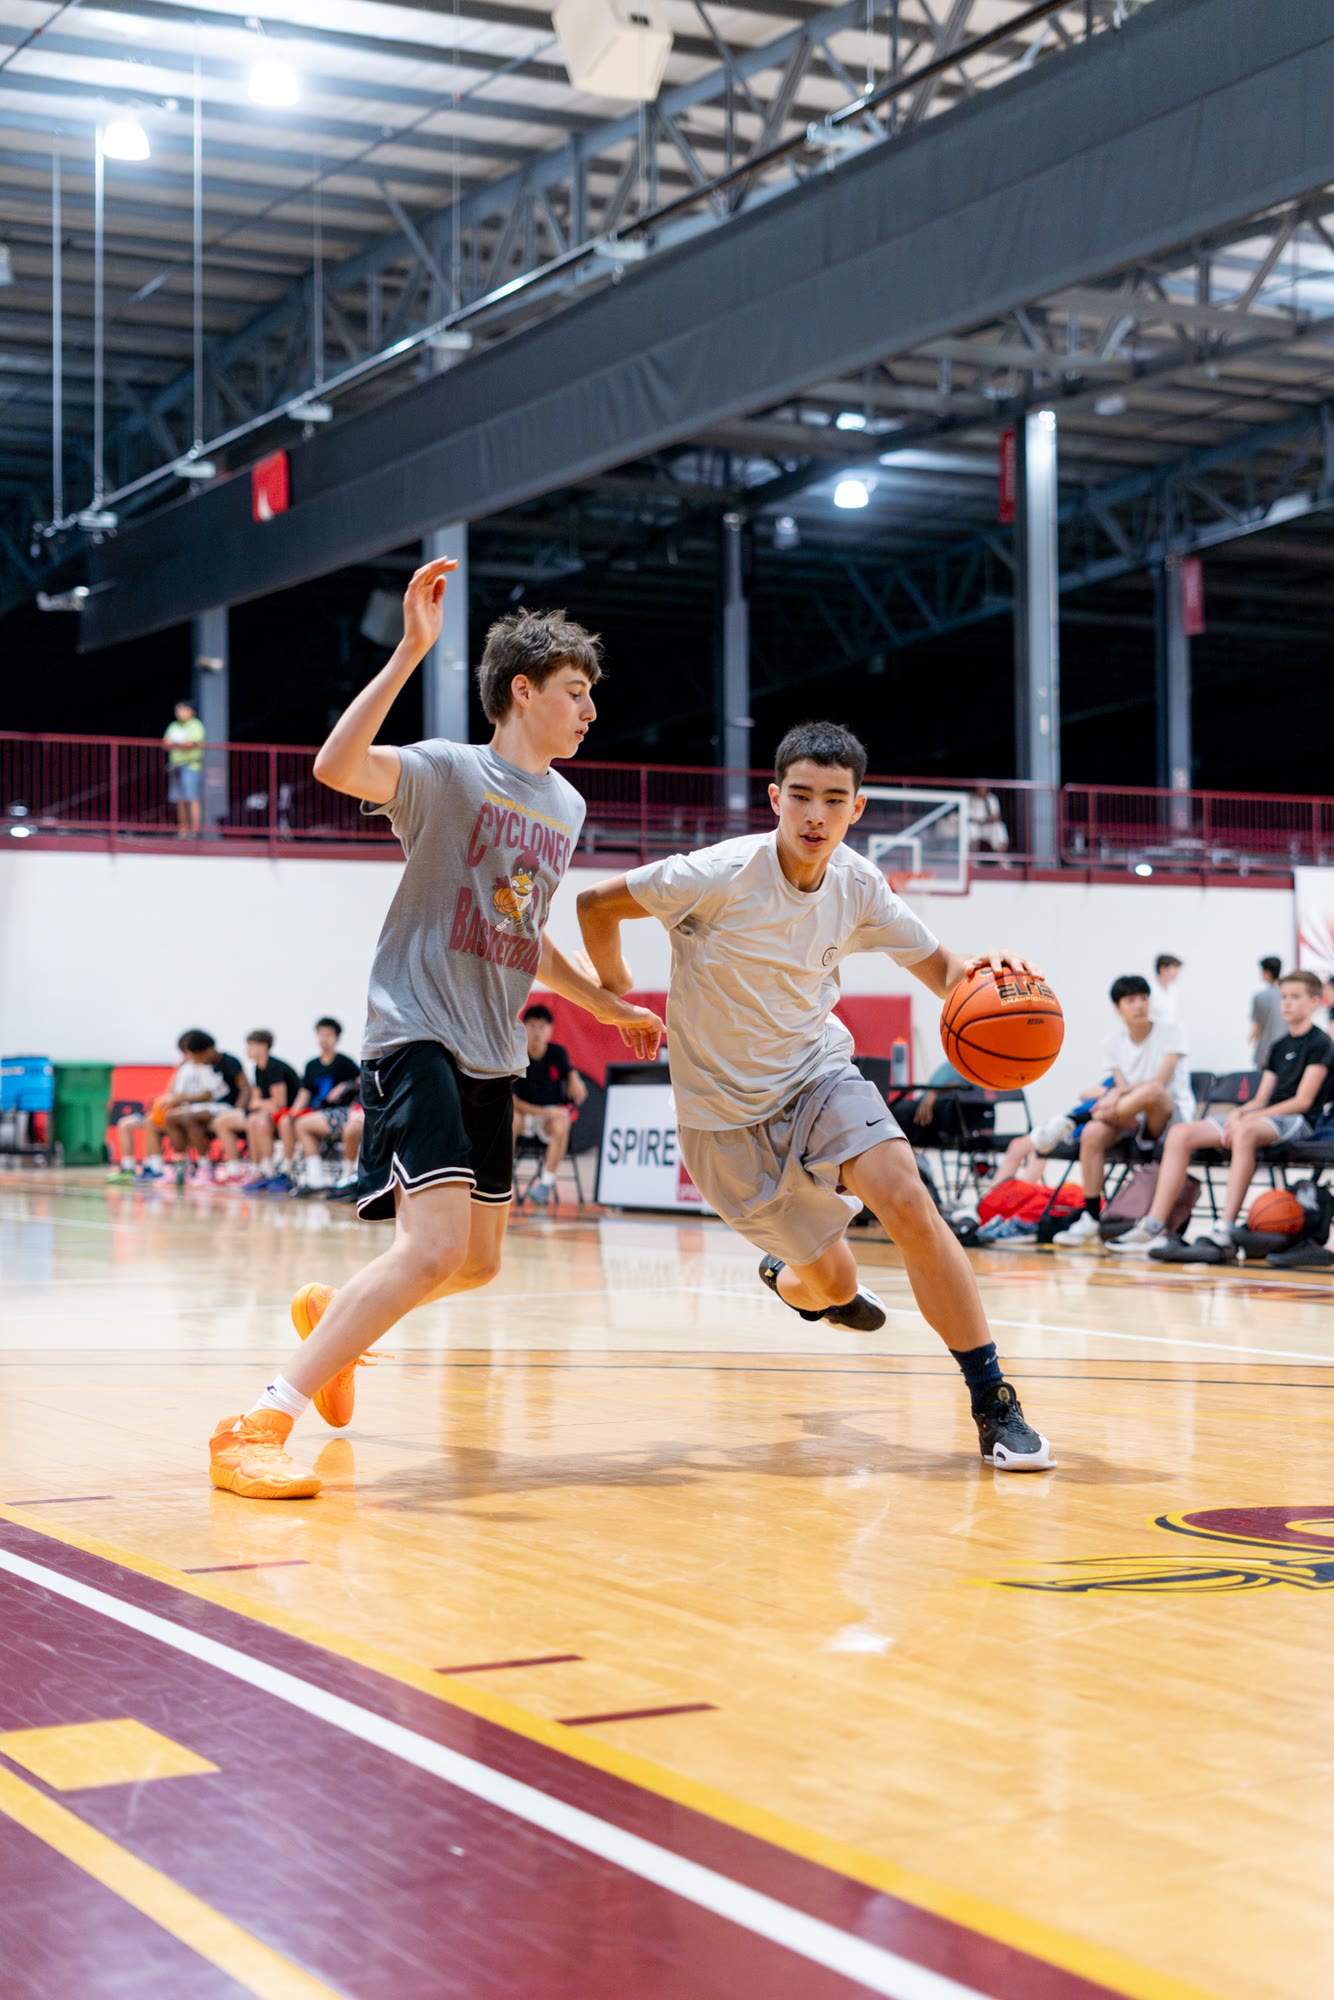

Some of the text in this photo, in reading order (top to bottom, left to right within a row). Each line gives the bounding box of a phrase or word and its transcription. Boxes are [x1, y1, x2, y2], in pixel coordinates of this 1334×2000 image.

[484, 790, 526, 815] IOWA
[996, 981, 1054, 1000] ELITE
[608, 1128, 676, 1167] SPIRE
